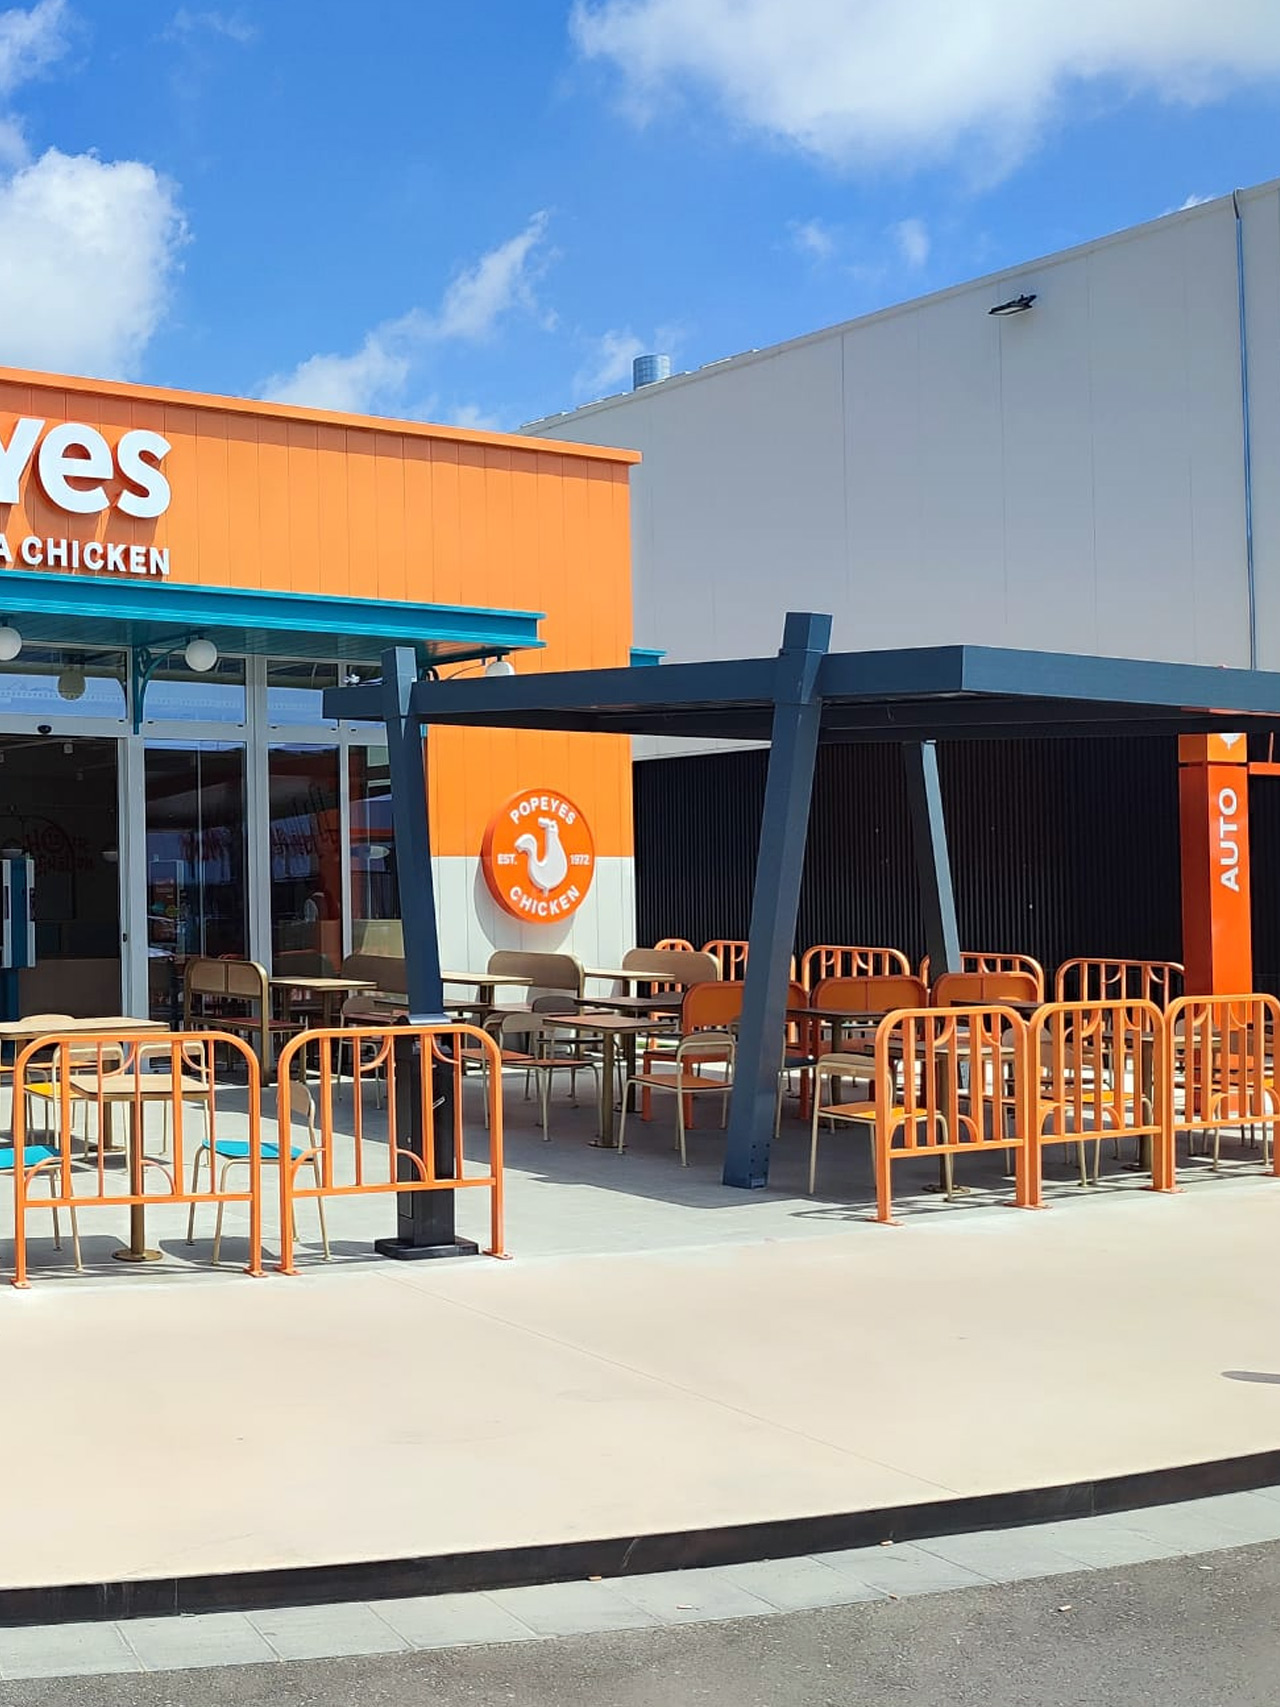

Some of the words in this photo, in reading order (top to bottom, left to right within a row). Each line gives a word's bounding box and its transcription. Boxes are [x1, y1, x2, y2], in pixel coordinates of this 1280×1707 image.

[21, 534, 171, 575] CHICKEN
[509, 796, 577, 825] POPEYES
[1218, 787, 1240, 893] AUTO
[496, 853, 518, 865] EST.
[570, 853, 590, 866] 1972
[510, 885, 581, 917] CHICKEN
